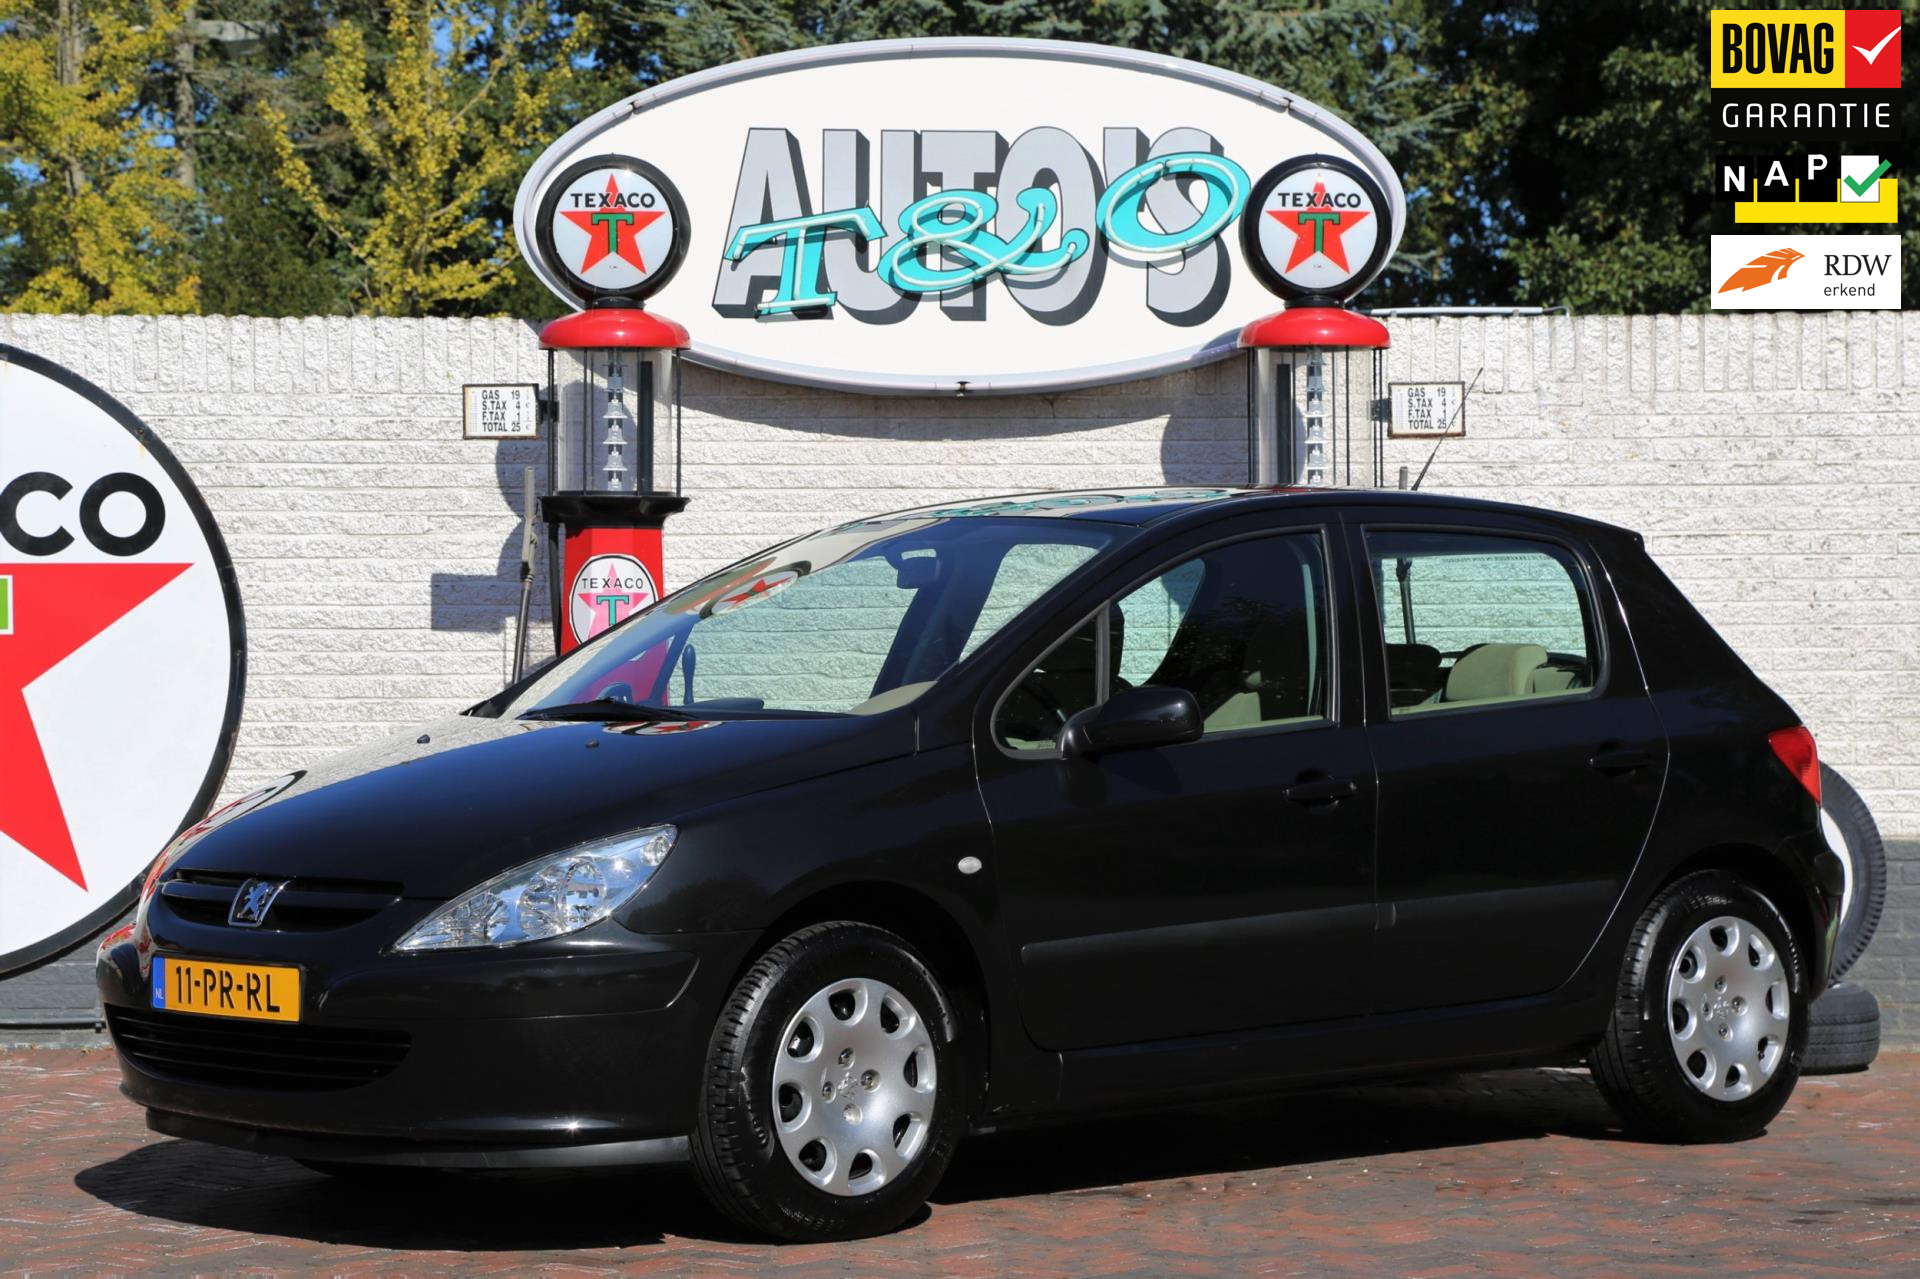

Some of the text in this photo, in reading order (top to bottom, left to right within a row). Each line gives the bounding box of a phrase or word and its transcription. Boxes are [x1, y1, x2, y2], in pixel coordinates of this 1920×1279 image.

[571, 192, 655, 209] TEXACO
[1277, 192, 1361, 208] TEXACO
[712, 126, 1231, 326] AUTO'S
[482, 389, 520, 400] GAS 19
[1408, 387, 1446, 398] GAS 19
[482, 400, 507, 411] S.TAX
[1408, 398, 1433, 409] S.TAX
[482, 411, 506, 421] F.TAX
[482, 422, 521, 432] TOTAL 25
[1408, 419, 1446, 430] TOTAL 25
[582, 578, 643, 589] TEXACO
[155, 988, 164, 1000] NL
[175, 966, 280, 1013] 11-PR-RL
